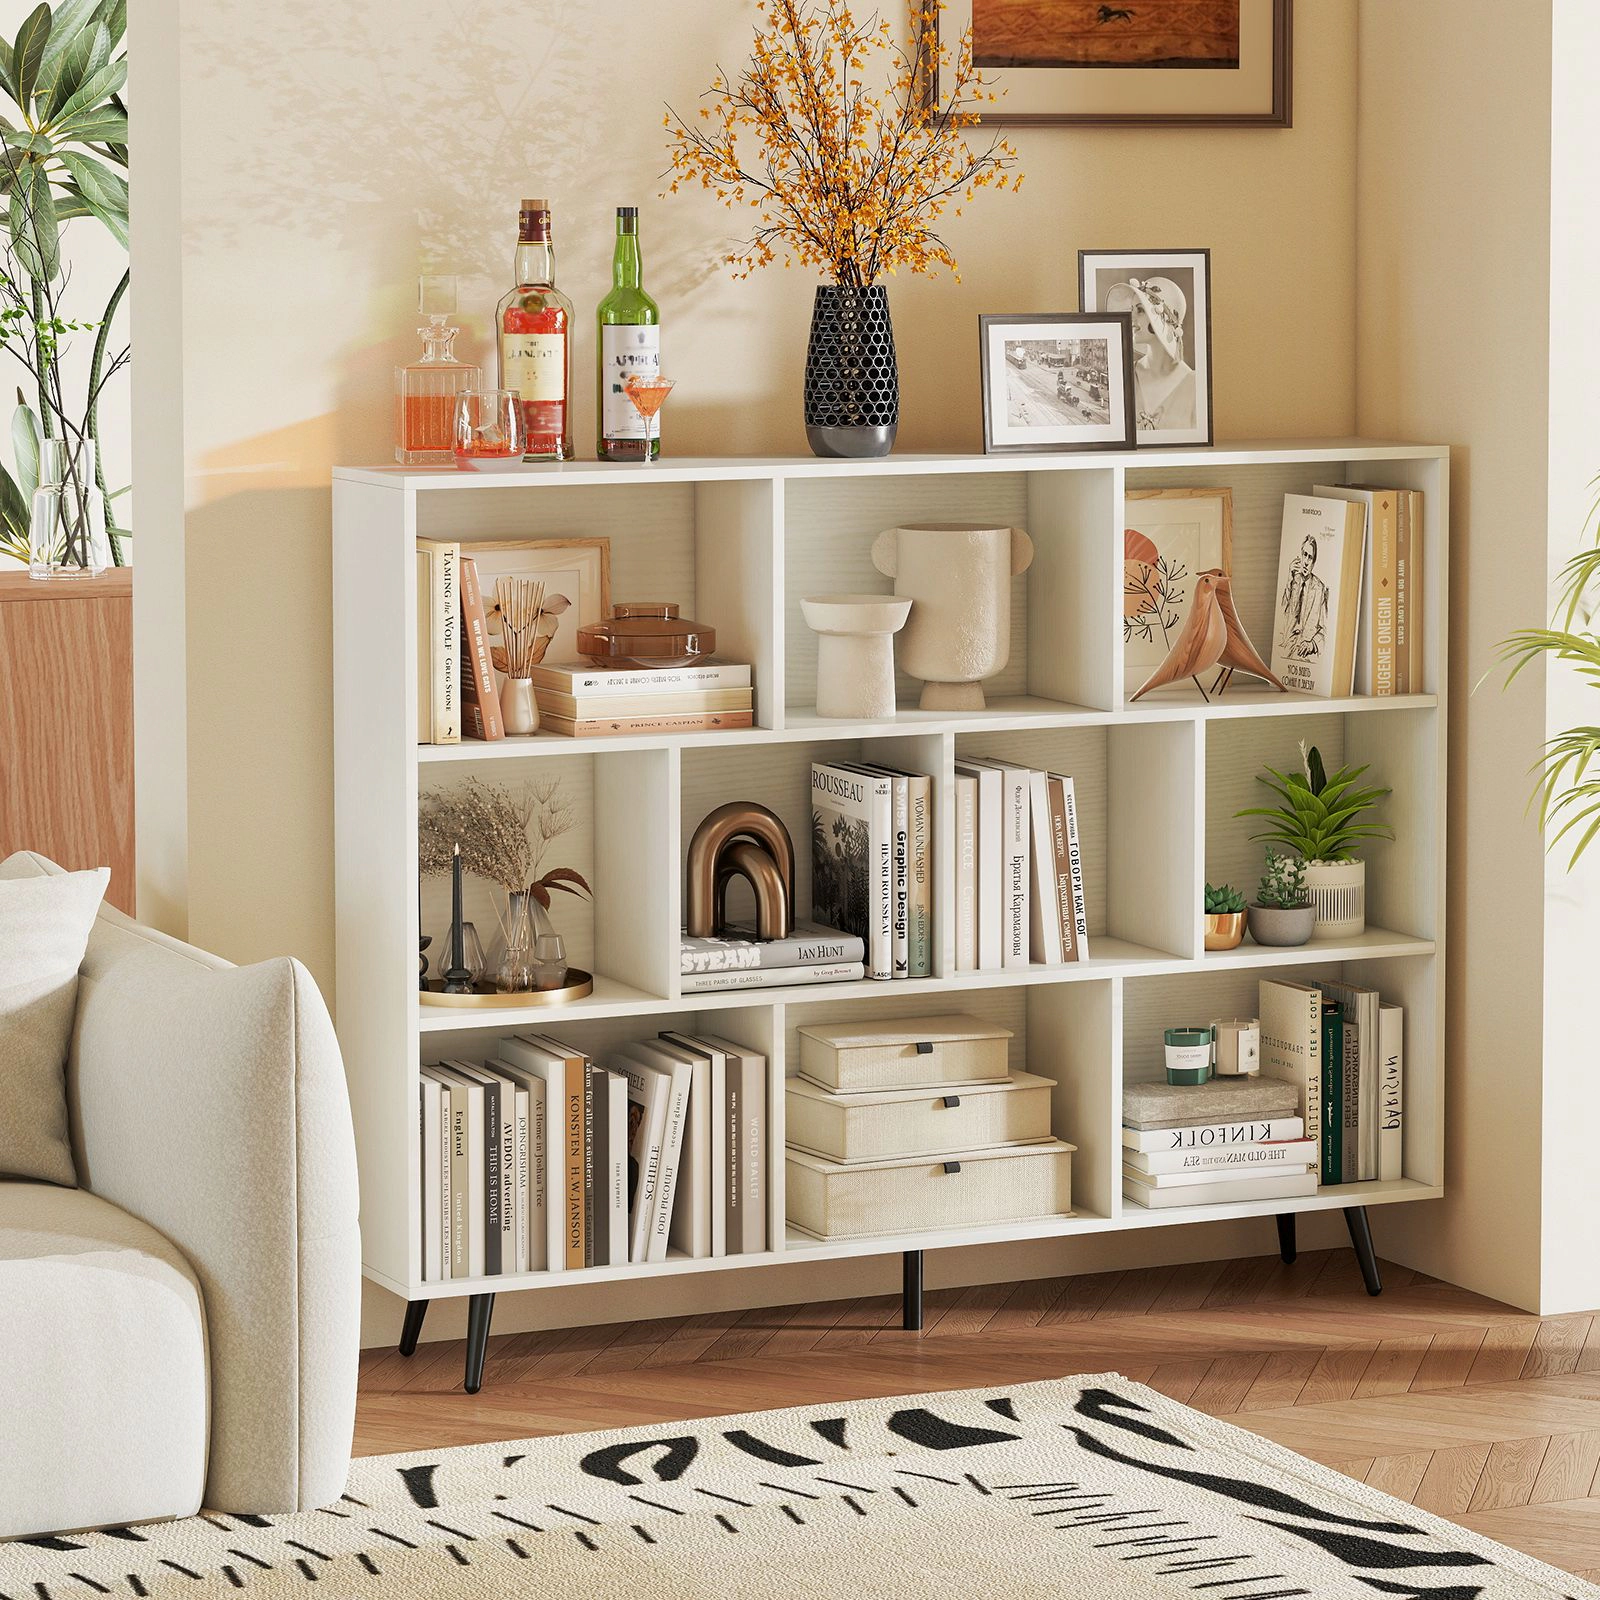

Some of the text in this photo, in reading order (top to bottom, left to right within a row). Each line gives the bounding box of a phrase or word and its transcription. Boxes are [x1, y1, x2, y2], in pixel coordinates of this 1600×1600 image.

[443, 550, 454, 651] TAMING the WOLF
[1398, 580, 1405, 590] DO
[1398, 592, 1405, 604] WE
[445, 657, 453, 682] GREG
[472, 618, 491, 693] WHY DO WE LOVE CATS
[1377, 596, 1392, 696] EUGENE ONEGIN
[812, 770, 864, 803] ROUSSEAU
[894, 784, 906, 940] Swiss Graphic Design
[914, 796, 924, 884] WOMAN UNLEASHED
[1010, 855, 1024, 956] Братья Карамазовы
[1058, 873, 1072, 952] Бархатная смерть
[1070, 842, 1086, 936] ГОВОРИ КАК БОГ
[682, 947, 761, 973] STEAM
[798, 946, 844, 960] IAN HUNT
[714, 977, 730, 986] PAIRS
[731, 976, 738, 984] OF
[740, 975, 763, 984] GLASSES
[536, 1099, 542, 1111] At
[670, 1092, 682, 1148] second glance
[454, 1111, 464, 1157] England
[536, 1143, 543, 1152] in
[750, 1117, 760, 1199] WORLD BALLET
[490, 1175, 497, 1186] IS
[503, 1122, 513, 1232] AVEDON advertising
[535, 1153, 544, 1185] Joshua
[570, 1095, 580, 1249] KONSTEN H.W.JANSON
[645, 1145, 660, 1200] SCHIELE
[490, 1188, 498, 1224] HOME
[536, 1188, 544, 1208] Tree
[658, 1166, 673, 1235] JODI PICOULT
